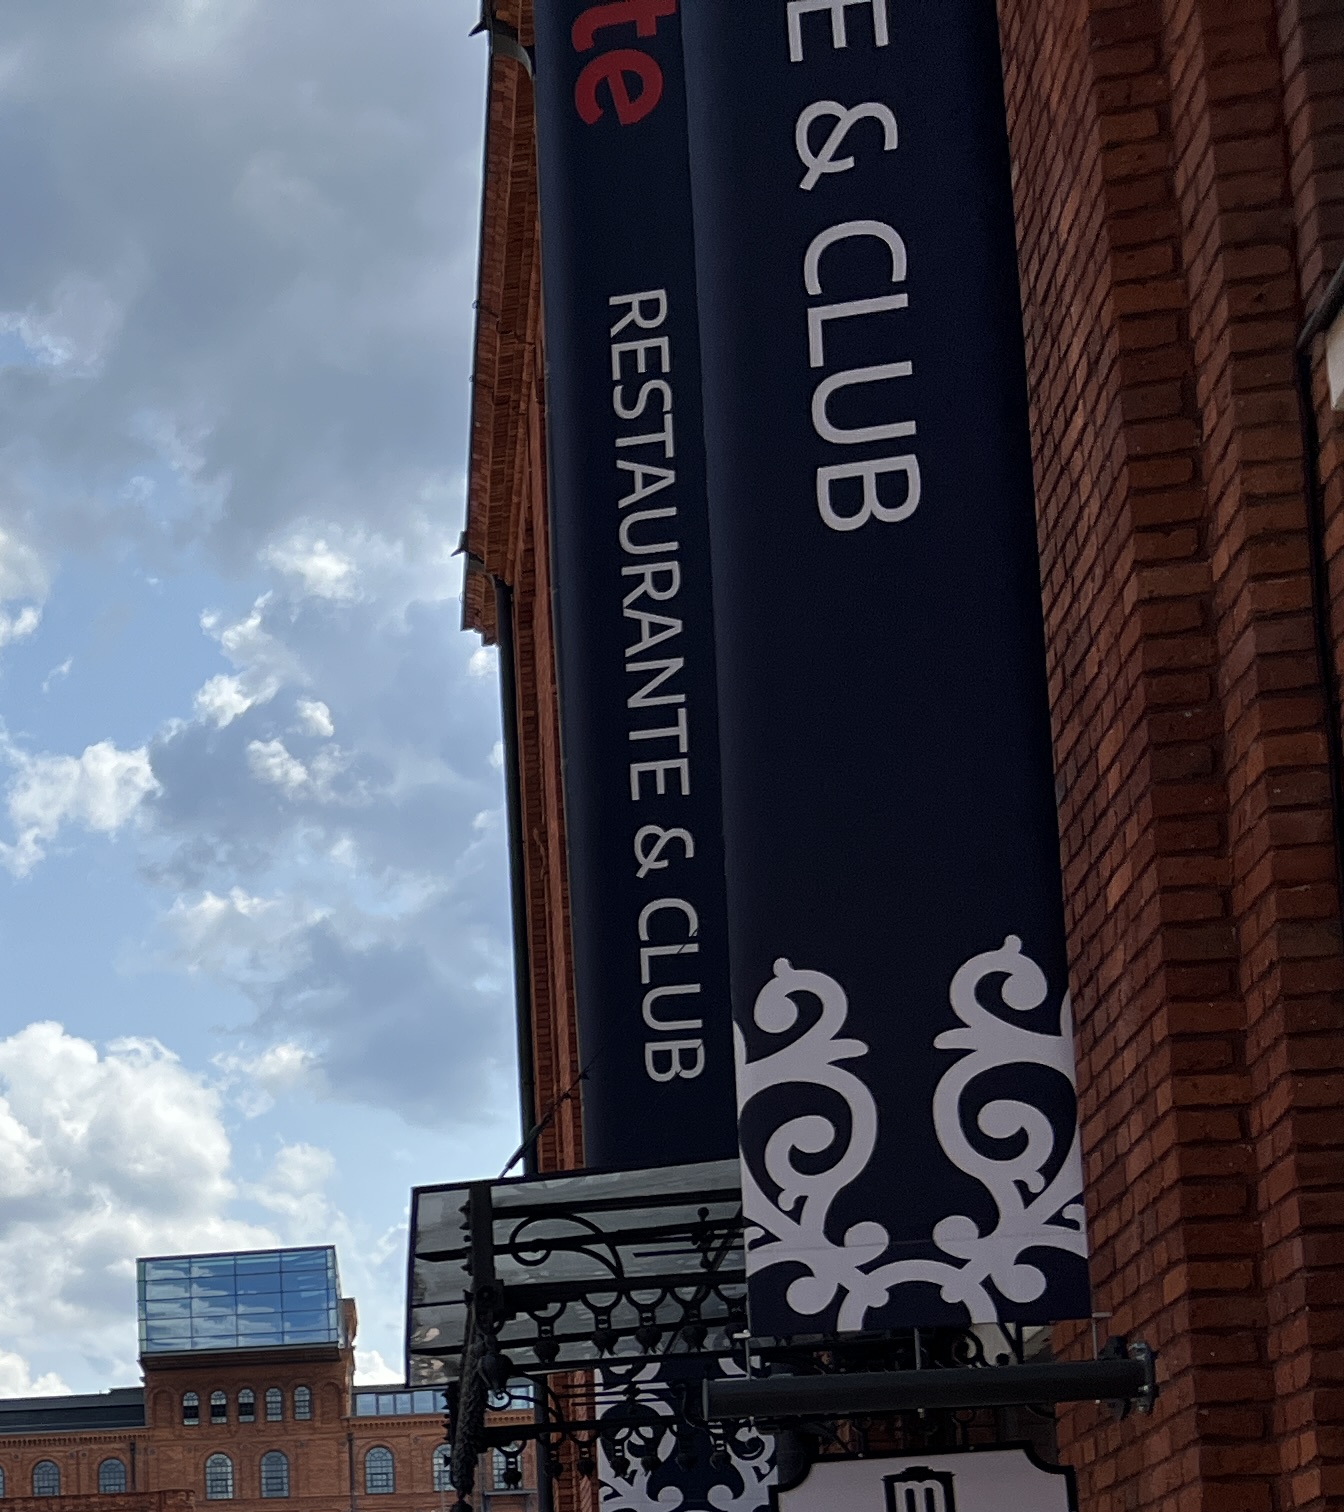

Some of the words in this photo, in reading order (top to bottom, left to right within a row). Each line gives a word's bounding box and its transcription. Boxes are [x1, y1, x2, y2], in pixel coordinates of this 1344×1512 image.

[571, 0, 676, 126] te
[795, 100, 899, 190] &
[803, 219, 921, 531] CLUB
[608, 288, 691, 801] RESTAURANTE
[633, 824, 695, 878] &
[637, 897, 705, 1083] CLUB
